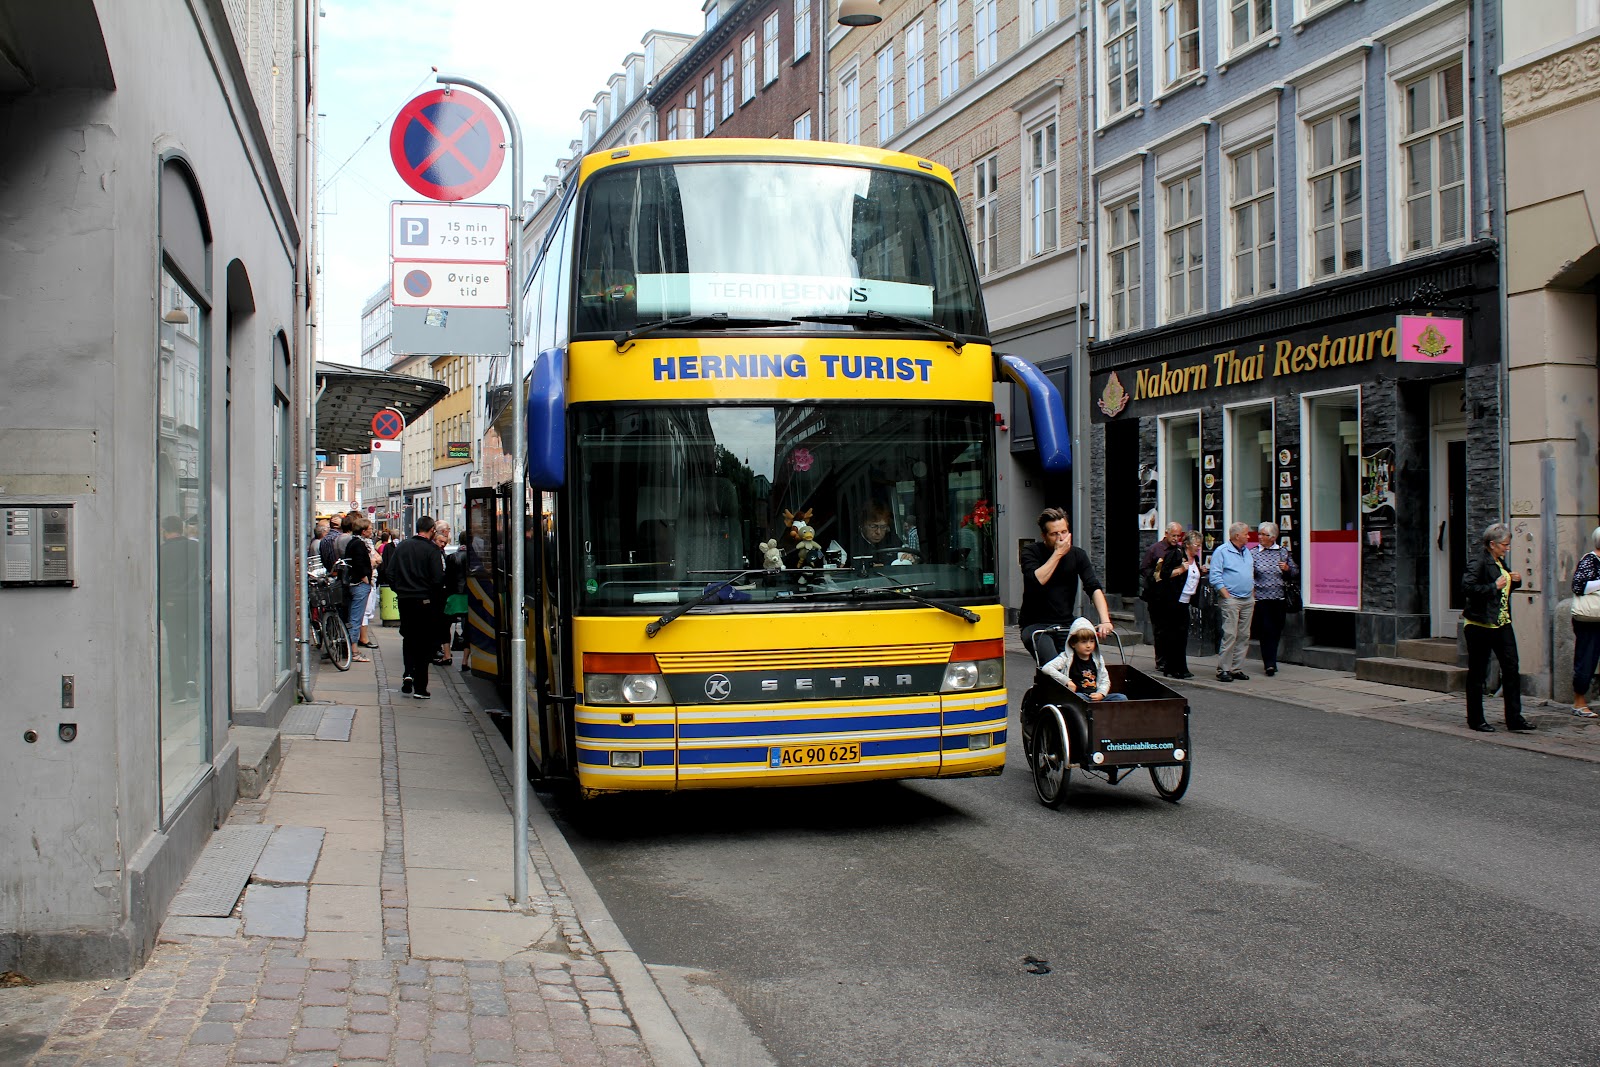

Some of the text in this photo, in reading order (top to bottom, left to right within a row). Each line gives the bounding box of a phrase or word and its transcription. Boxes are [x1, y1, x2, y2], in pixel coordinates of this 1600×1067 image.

[447, 222, 488, 232] 15 min
[440, 236, 495, 246] 7-9 15-17
[448, 273, 490, 284] Øvrige
[460, 287, 478, 297] tid
[652, 353, 933, 382] HERNING TURIST
[1134, 327, 1396, 400] Nakorn Thai Restaura
[761, 674, 912, 691] SETRA
[1107, 742, 1174, 751] christianiabikes.com
[782, 749, 803, 764] AG
[806, 748, 825, 762] 90
[829, 746, 858, 761] 625
